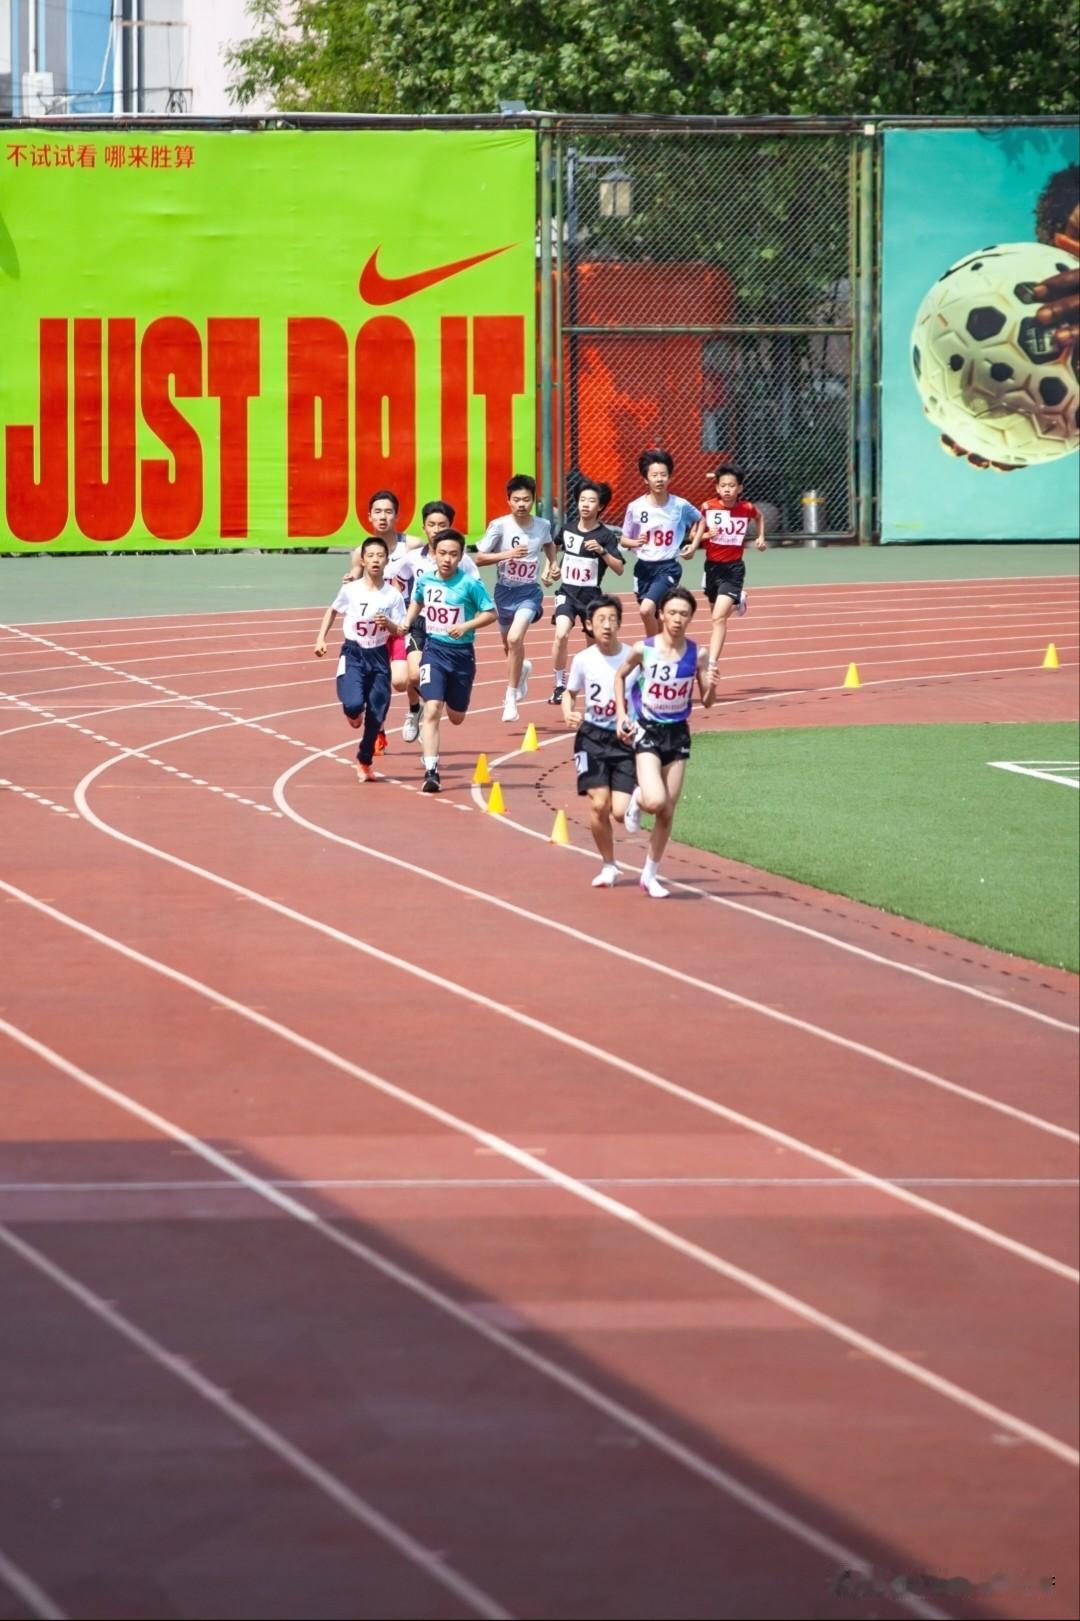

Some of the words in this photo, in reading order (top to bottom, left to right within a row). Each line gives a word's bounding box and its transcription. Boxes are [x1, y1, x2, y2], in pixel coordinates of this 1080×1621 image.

[6, 144, 96, 168] 不试试看
[104, 144, 195, 169] 哪来胜算
[5, 316, 260, 542] JUST
[287, 315, 416, 538] DO
[440, 315, 525, 536] IT
[640, 511, 649, 524] 8
[714, 512, 722, 525] 5
[511, 536, 520, 549] 6
[566, 536, 575, 549] 3
[507, 561, 537, 579] 302
[565, 566, 592, 582] 103
[426, 588, 443, 603] 12
[359, 602, 368, 617] 7
[426, 605, 460, 625] 087
[650, 663, 671, 682] 13
[589, 683, 602, 702] 2
